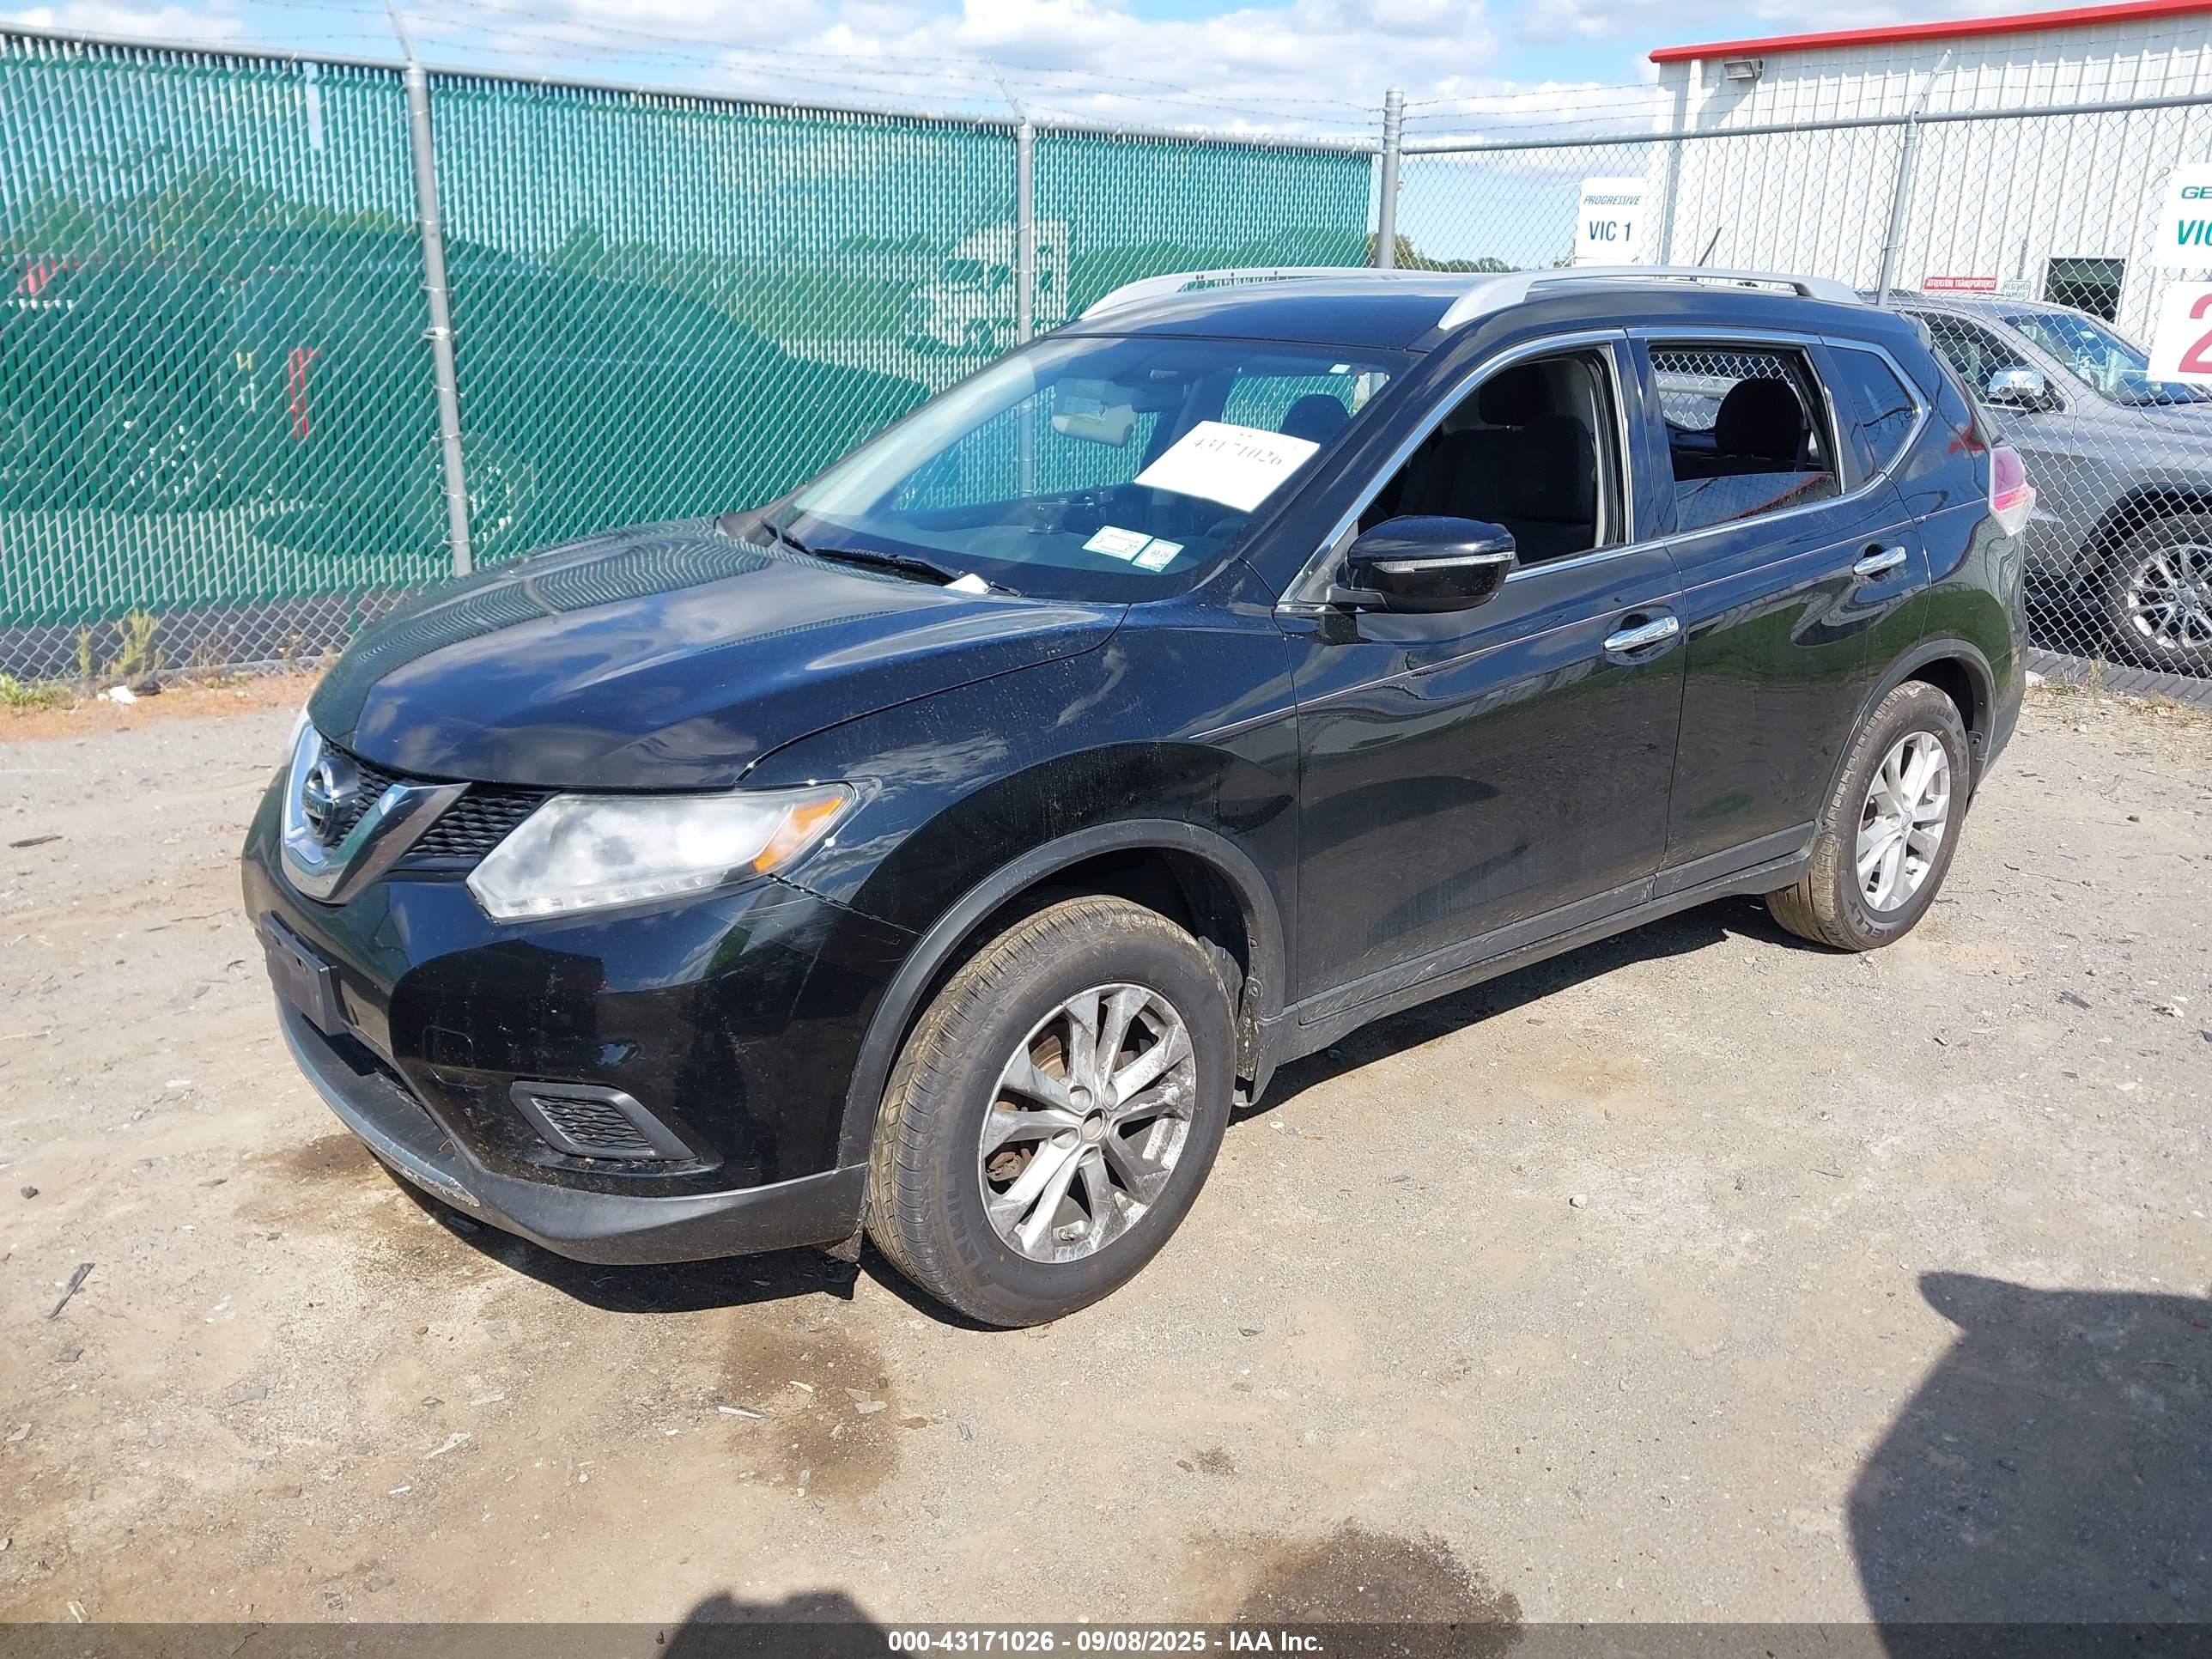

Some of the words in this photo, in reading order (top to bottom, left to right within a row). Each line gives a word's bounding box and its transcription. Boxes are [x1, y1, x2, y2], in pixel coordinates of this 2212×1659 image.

[1583, 195, 1642, 205] PROGRESSIVE
[1589, 220, 1617, 241] VIC
[1624, 221, 1632, 241] 1
